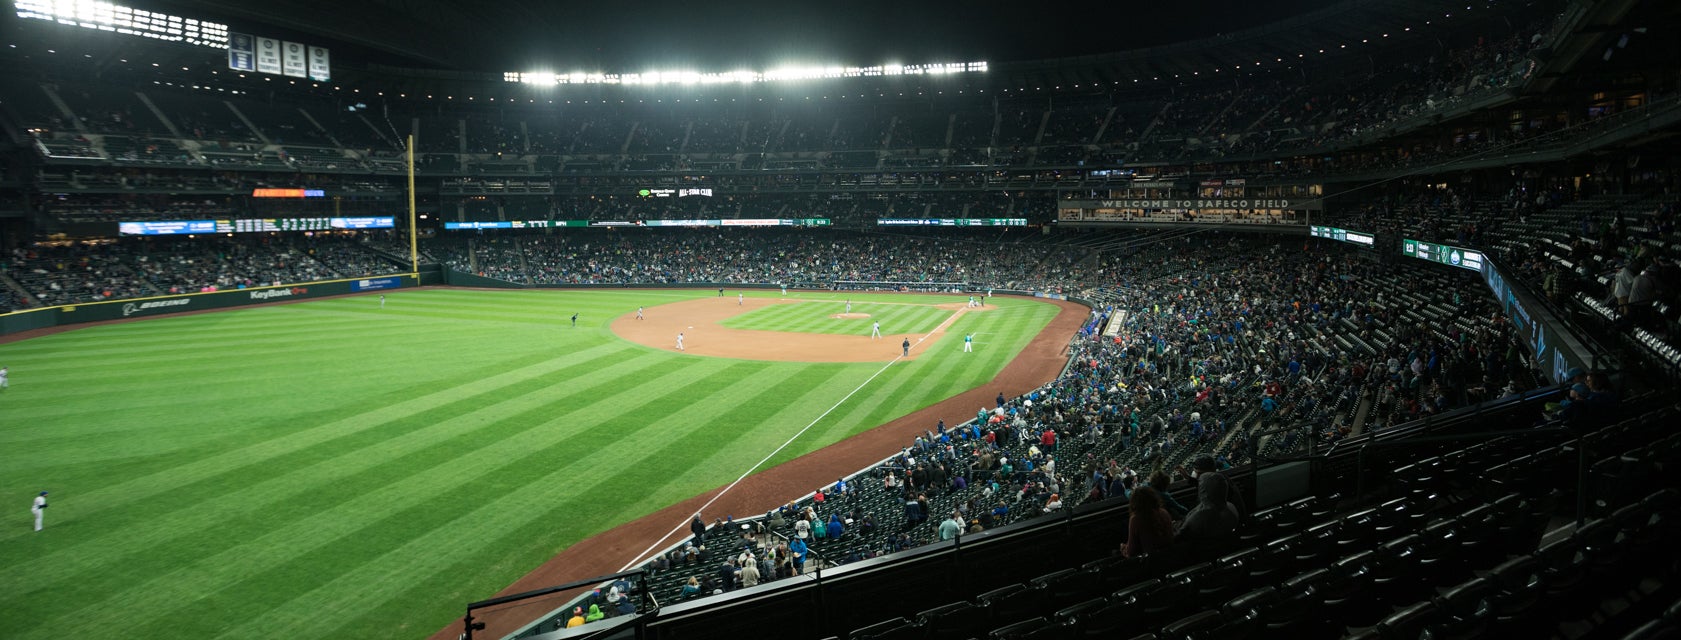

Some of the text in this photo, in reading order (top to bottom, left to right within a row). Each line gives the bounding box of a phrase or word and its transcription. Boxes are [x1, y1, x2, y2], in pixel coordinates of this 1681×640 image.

[1101, 199, 1289, 208] WELCOME TO SAFECO FIELD
[249, 288, 292, 300] KeyBank
[139, 298, 191, 309] BOEING
